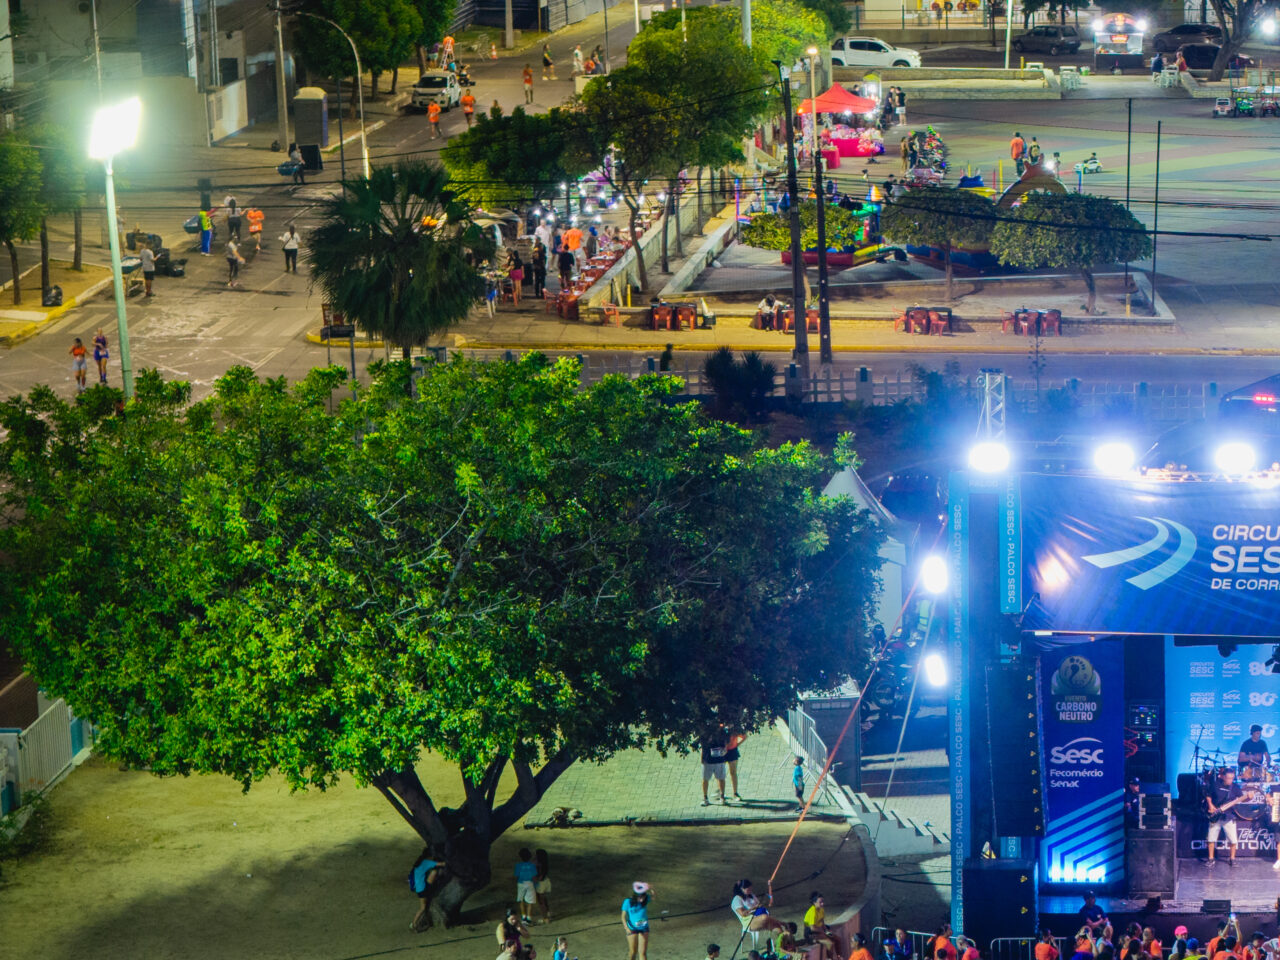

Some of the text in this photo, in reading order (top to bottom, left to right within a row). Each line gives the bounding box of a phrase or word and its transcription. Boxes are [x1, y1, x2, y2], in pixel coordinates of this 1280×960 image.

[1211, 578, 1232, 590] DE
[1055, 701, 1097, 711] CARBONO
[1059, 711, 1093, 721] NEUTRO
[1050, 737, 1104, 764] Sesc
[1050, 768, 1104, 777] Fecomércio
[955, 775, 963, 799] SESC
[1050, 779, 1090, 788] Senac
